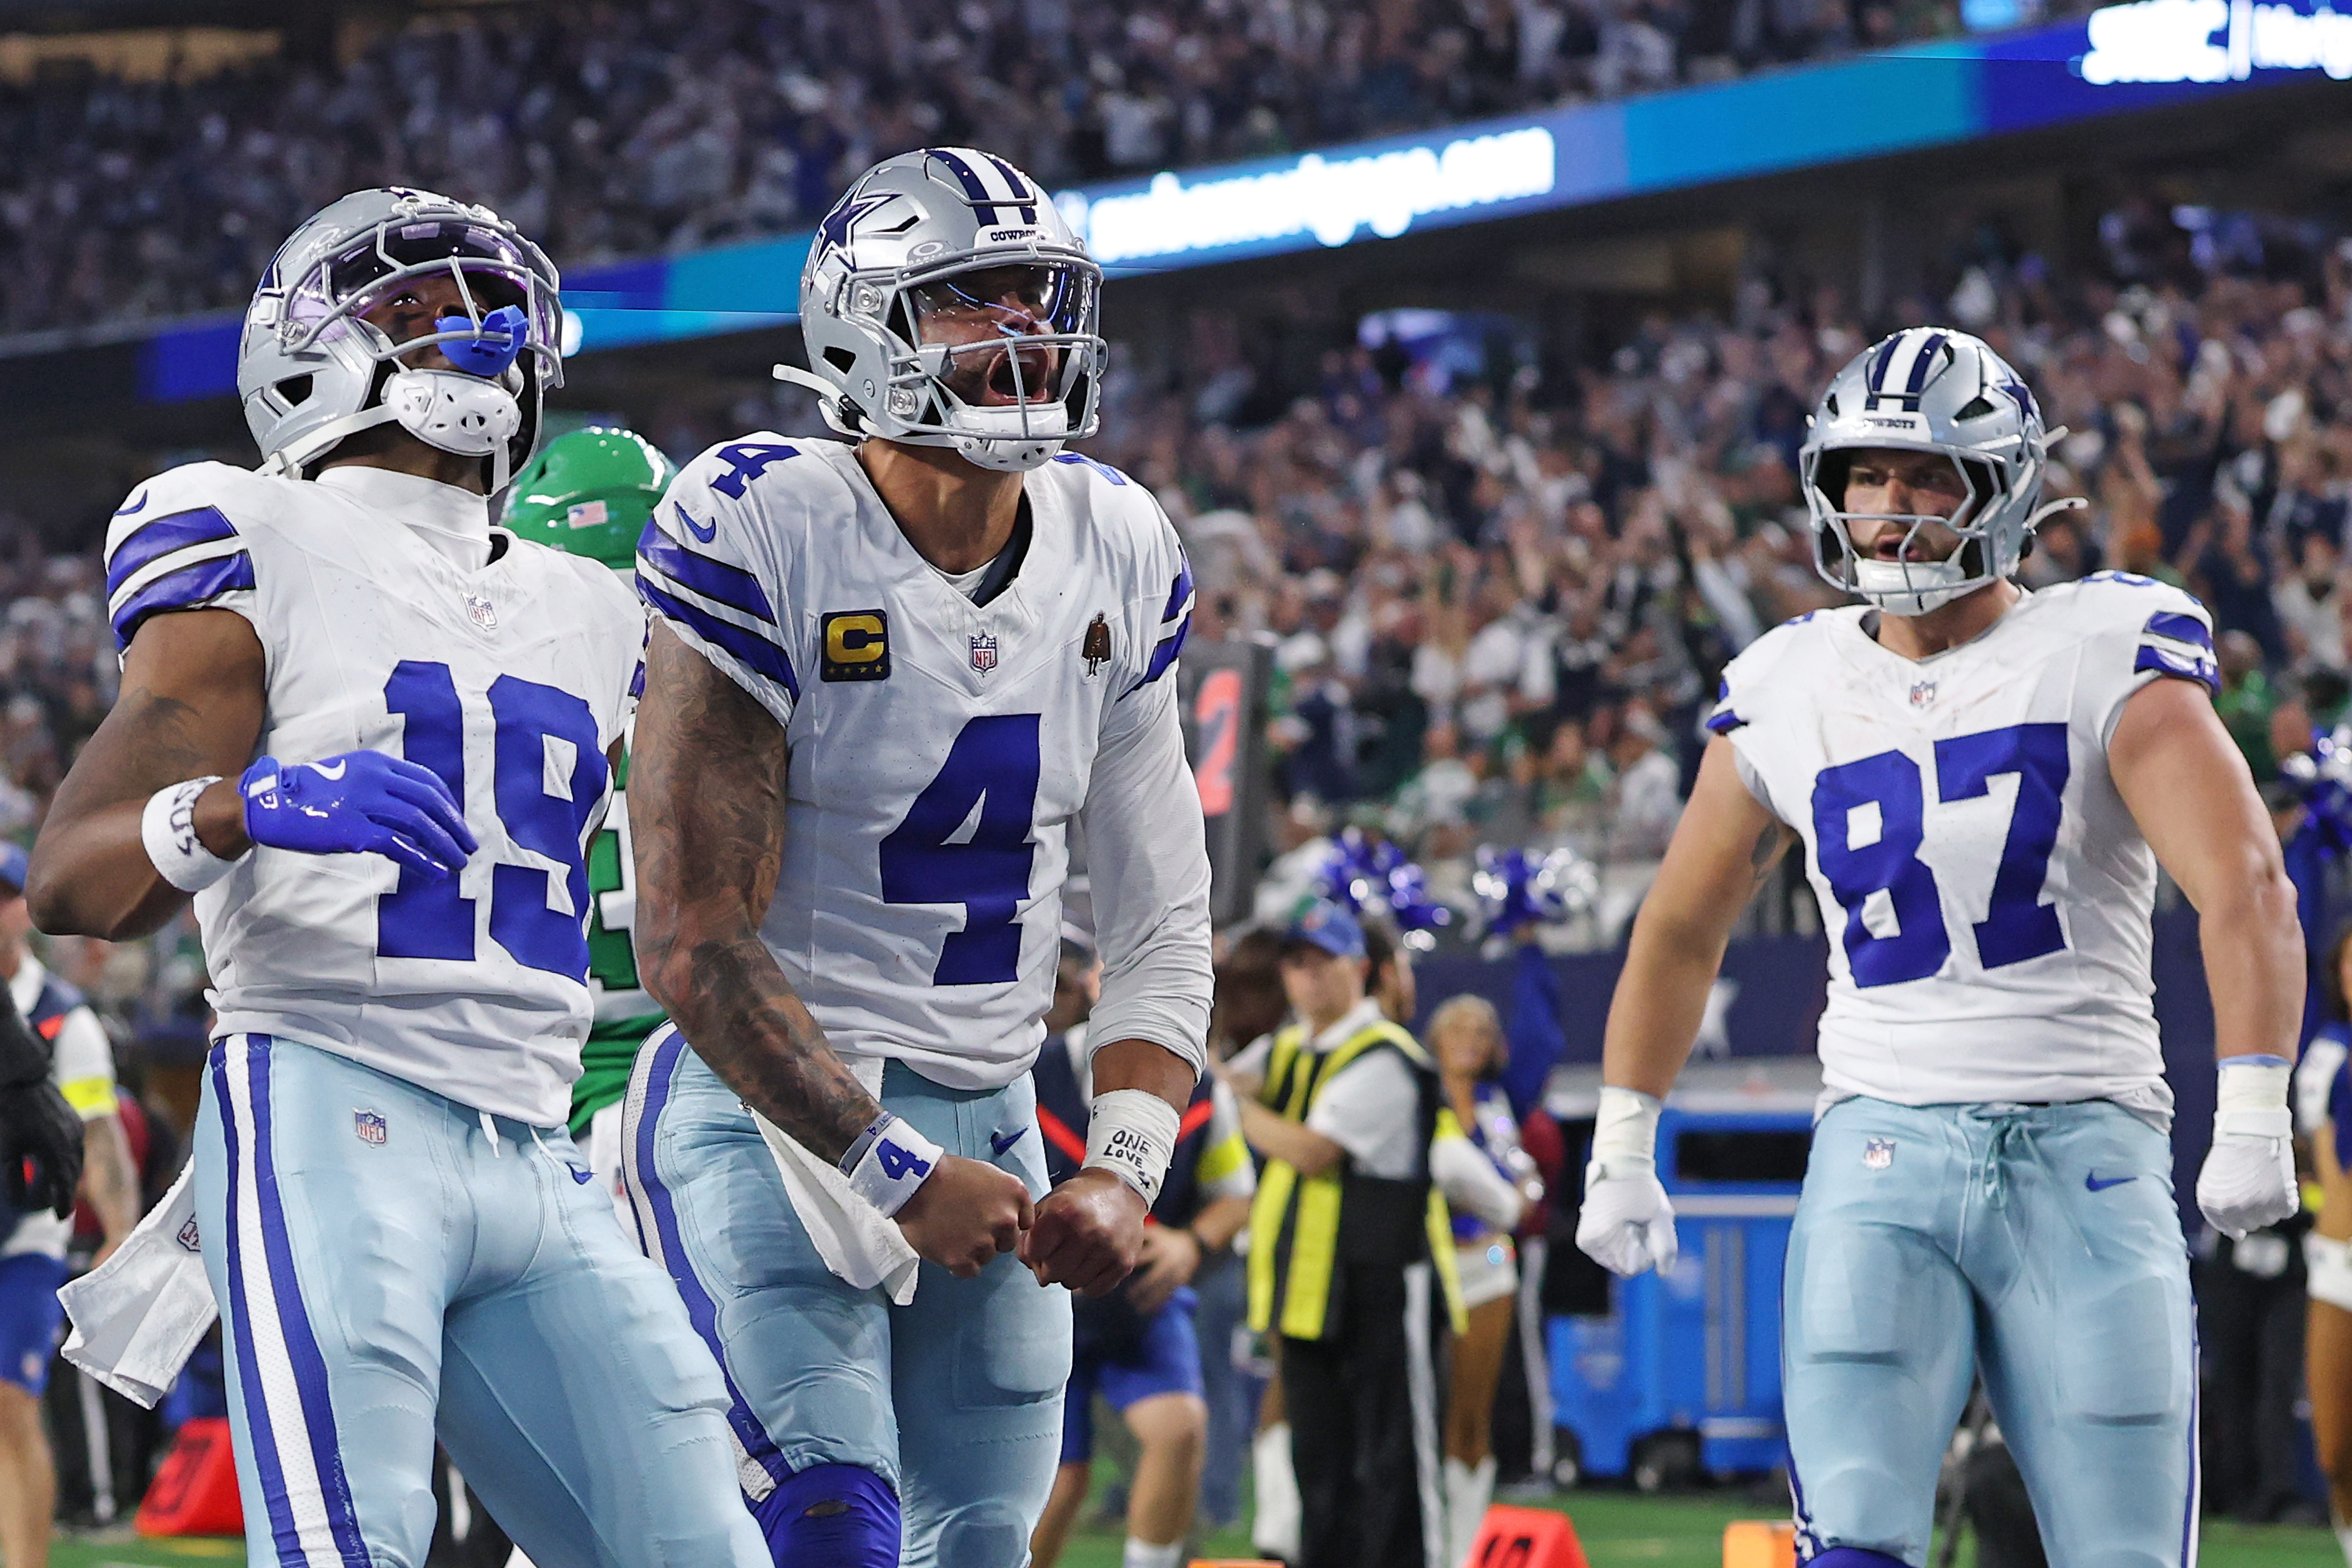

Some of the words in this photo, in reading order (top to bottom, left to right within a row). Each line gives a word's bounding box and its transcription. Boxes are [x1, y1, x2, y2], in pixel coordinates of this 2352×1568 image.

[990, 230, 1045, 241] COWBO
[1863, 418, 1916, 430] WBOYS
[709, 443, 802, 500] 4
[827, 615, 884, 663] C
[975, 650, 995, 668] NFL
[1194, 670, 1242, 817] 2
[377, 660, 609, 987] 19
[879, 713, 1041, 986] 4
[1811, 722, 2070, 989] 87
[359, 1123, 384, 1141] NFL
[1112, 1130, 1151, 1155] ONE
[876, 1138, 931, 1180] 4
[1103, 1144, 1143, 1169] LOVE
